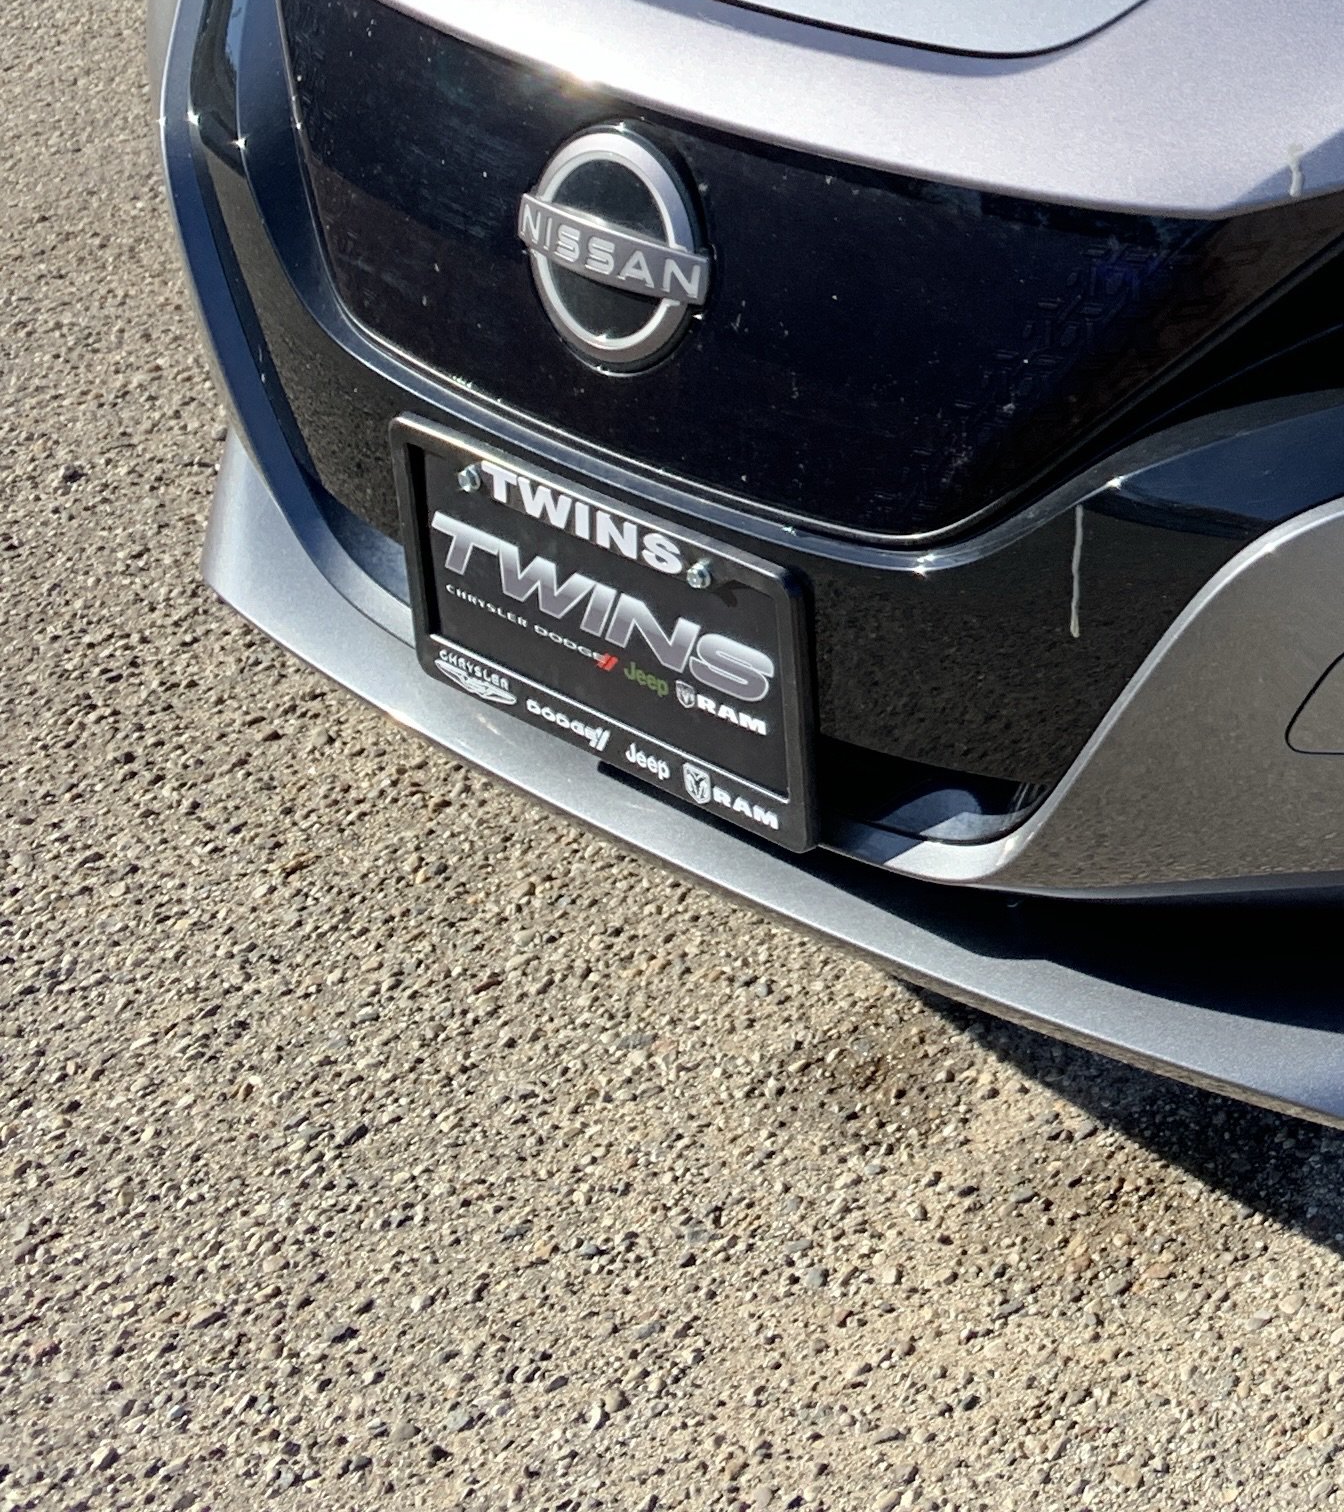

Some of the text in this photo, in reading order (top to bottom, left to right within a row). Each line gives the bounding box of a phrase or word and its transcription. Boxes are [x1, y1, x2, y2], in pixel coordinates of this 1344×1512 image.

[520, 204, 701, 299] NISSAN
[481, 460, 684, 575] TWINS
[431, 510, 775, 702] TWINS
[445, 584, 768, 737] CHRYSLER DODGE Jeep RAM
[439, 649, 780, 831] CHRYSLER DODGE Jeep RAM
